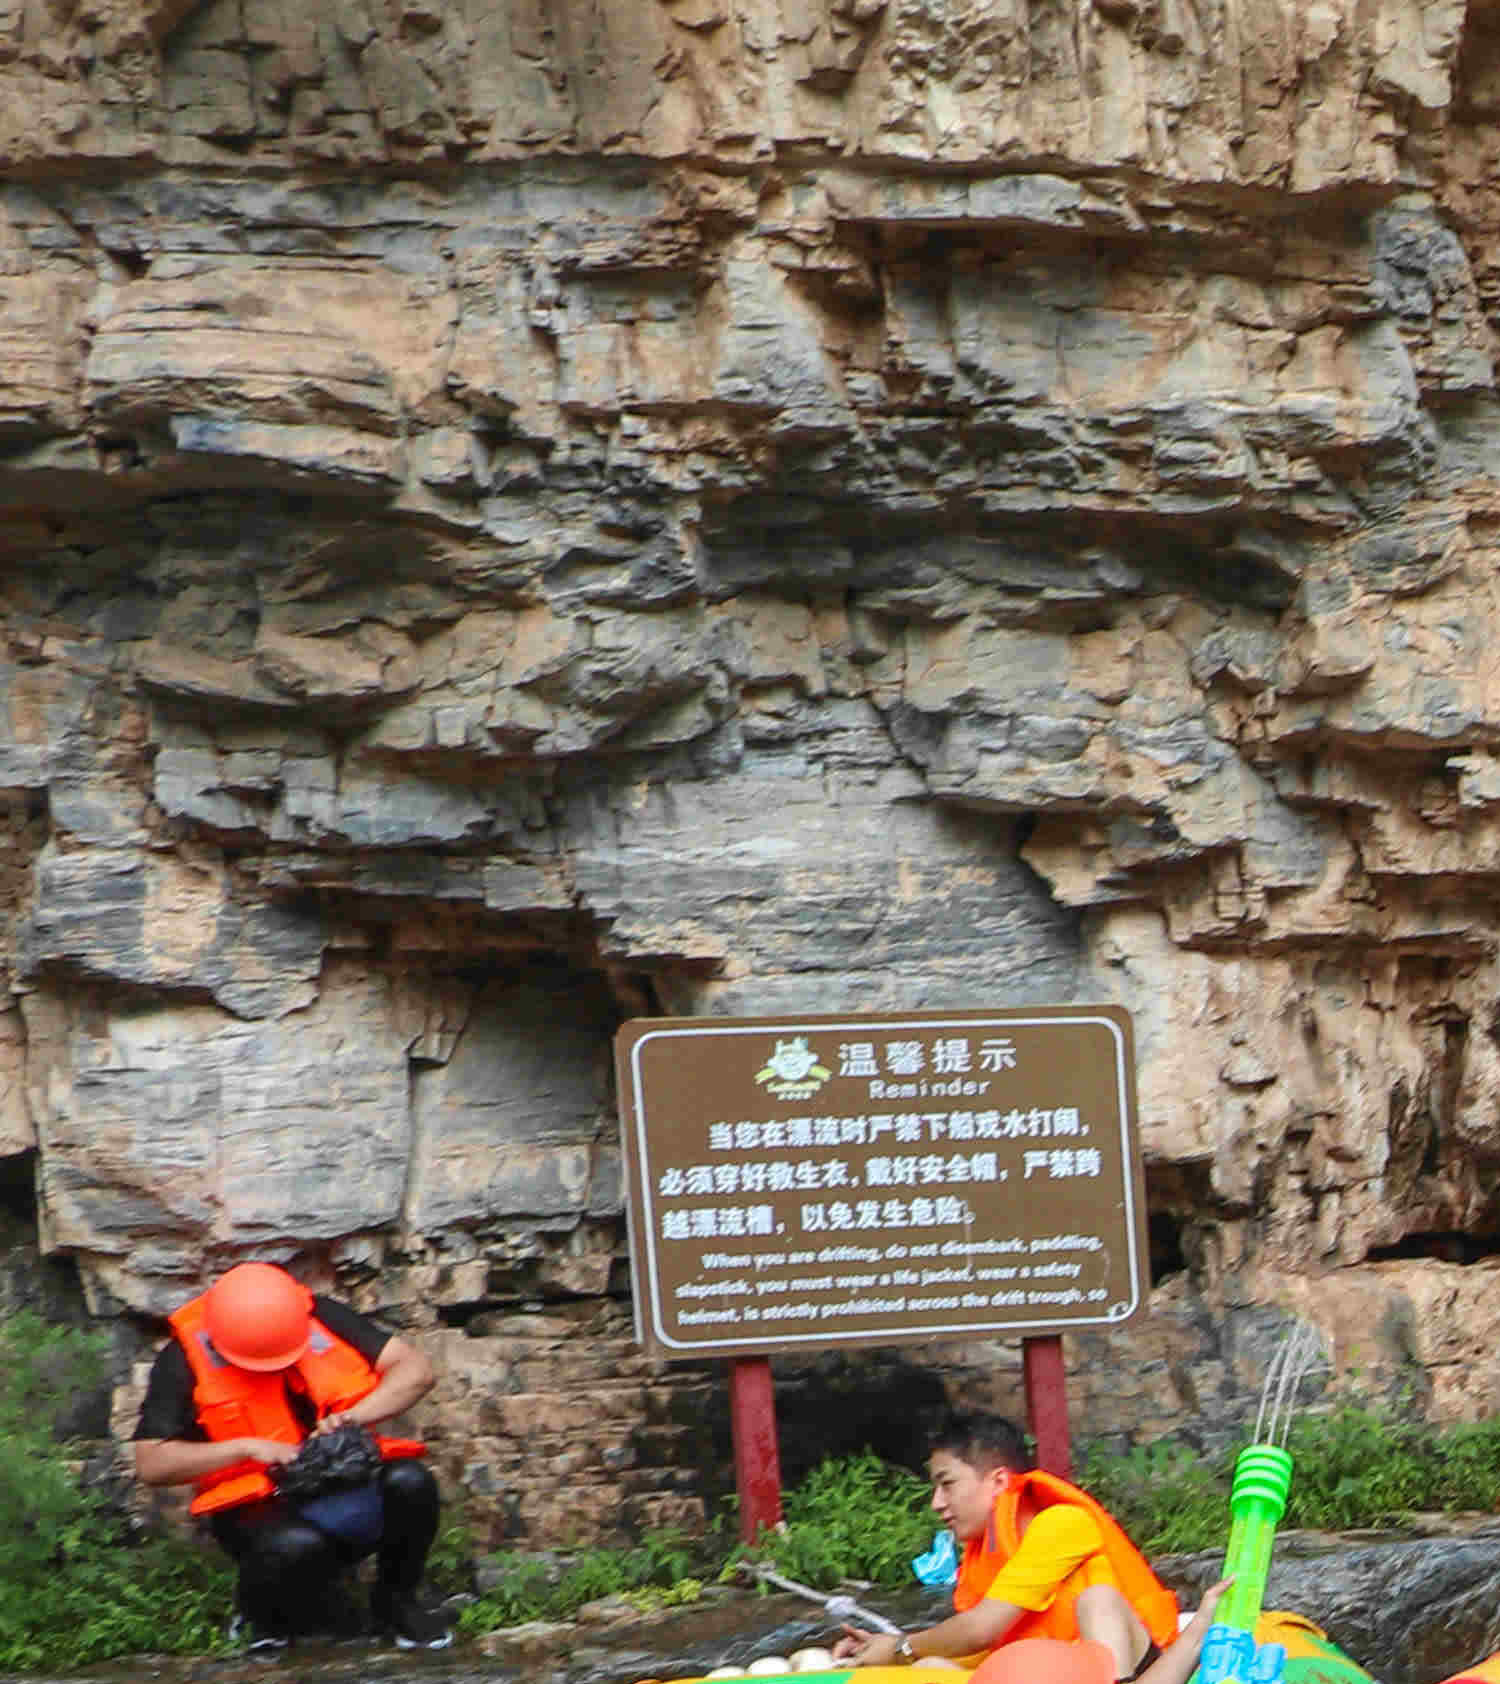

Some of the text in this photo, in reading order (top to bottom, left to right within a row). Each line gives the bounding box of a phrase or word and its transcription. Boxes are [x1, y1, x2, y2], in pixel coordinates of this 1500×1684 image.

[838, 1038, 1017, 1077] 温馨提示
[868, 1078, 991, 1099] Reminder
[753, 1254, 786, 1271] you
[755, 1280, 788, 1296] you
